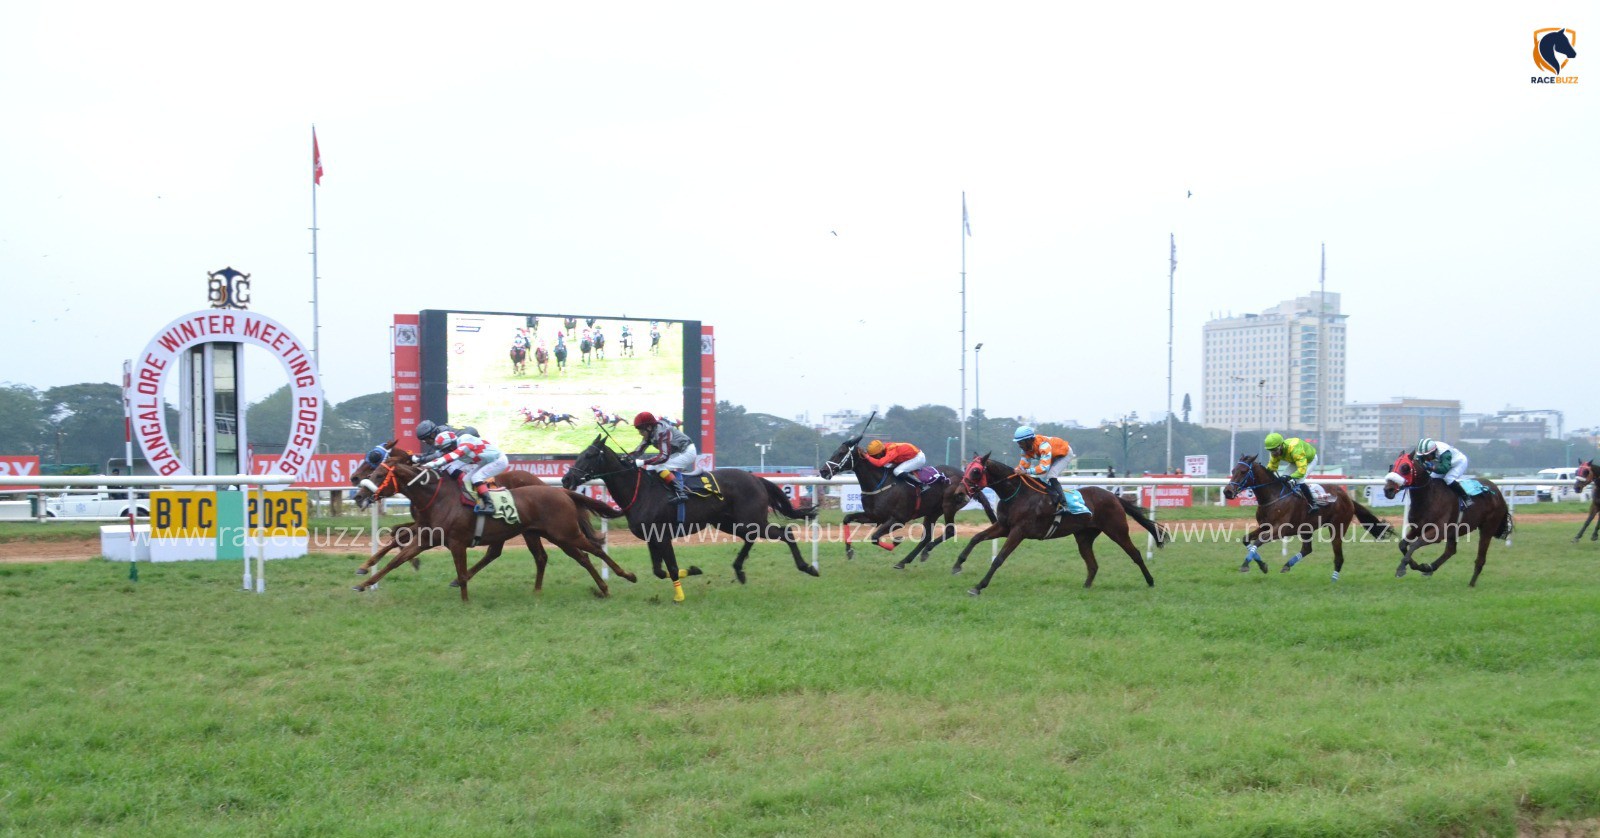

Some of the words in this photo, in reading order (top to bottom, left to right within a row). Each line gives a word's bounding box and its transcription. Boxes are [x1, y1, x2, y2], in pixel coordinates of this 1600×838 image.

[136, 353, 180, 476] BANGALORE
[158, 315, 235, 353] WINTER
[243, 317, 315, 389] MEETING
[280, 396, 318, 476] 2025-26
[330, 459, 345, 483] S.
[156, 498, 212, 529] BTC
[248, 498, 303, 528] 2025
[499, 505, 517, 521] 12
